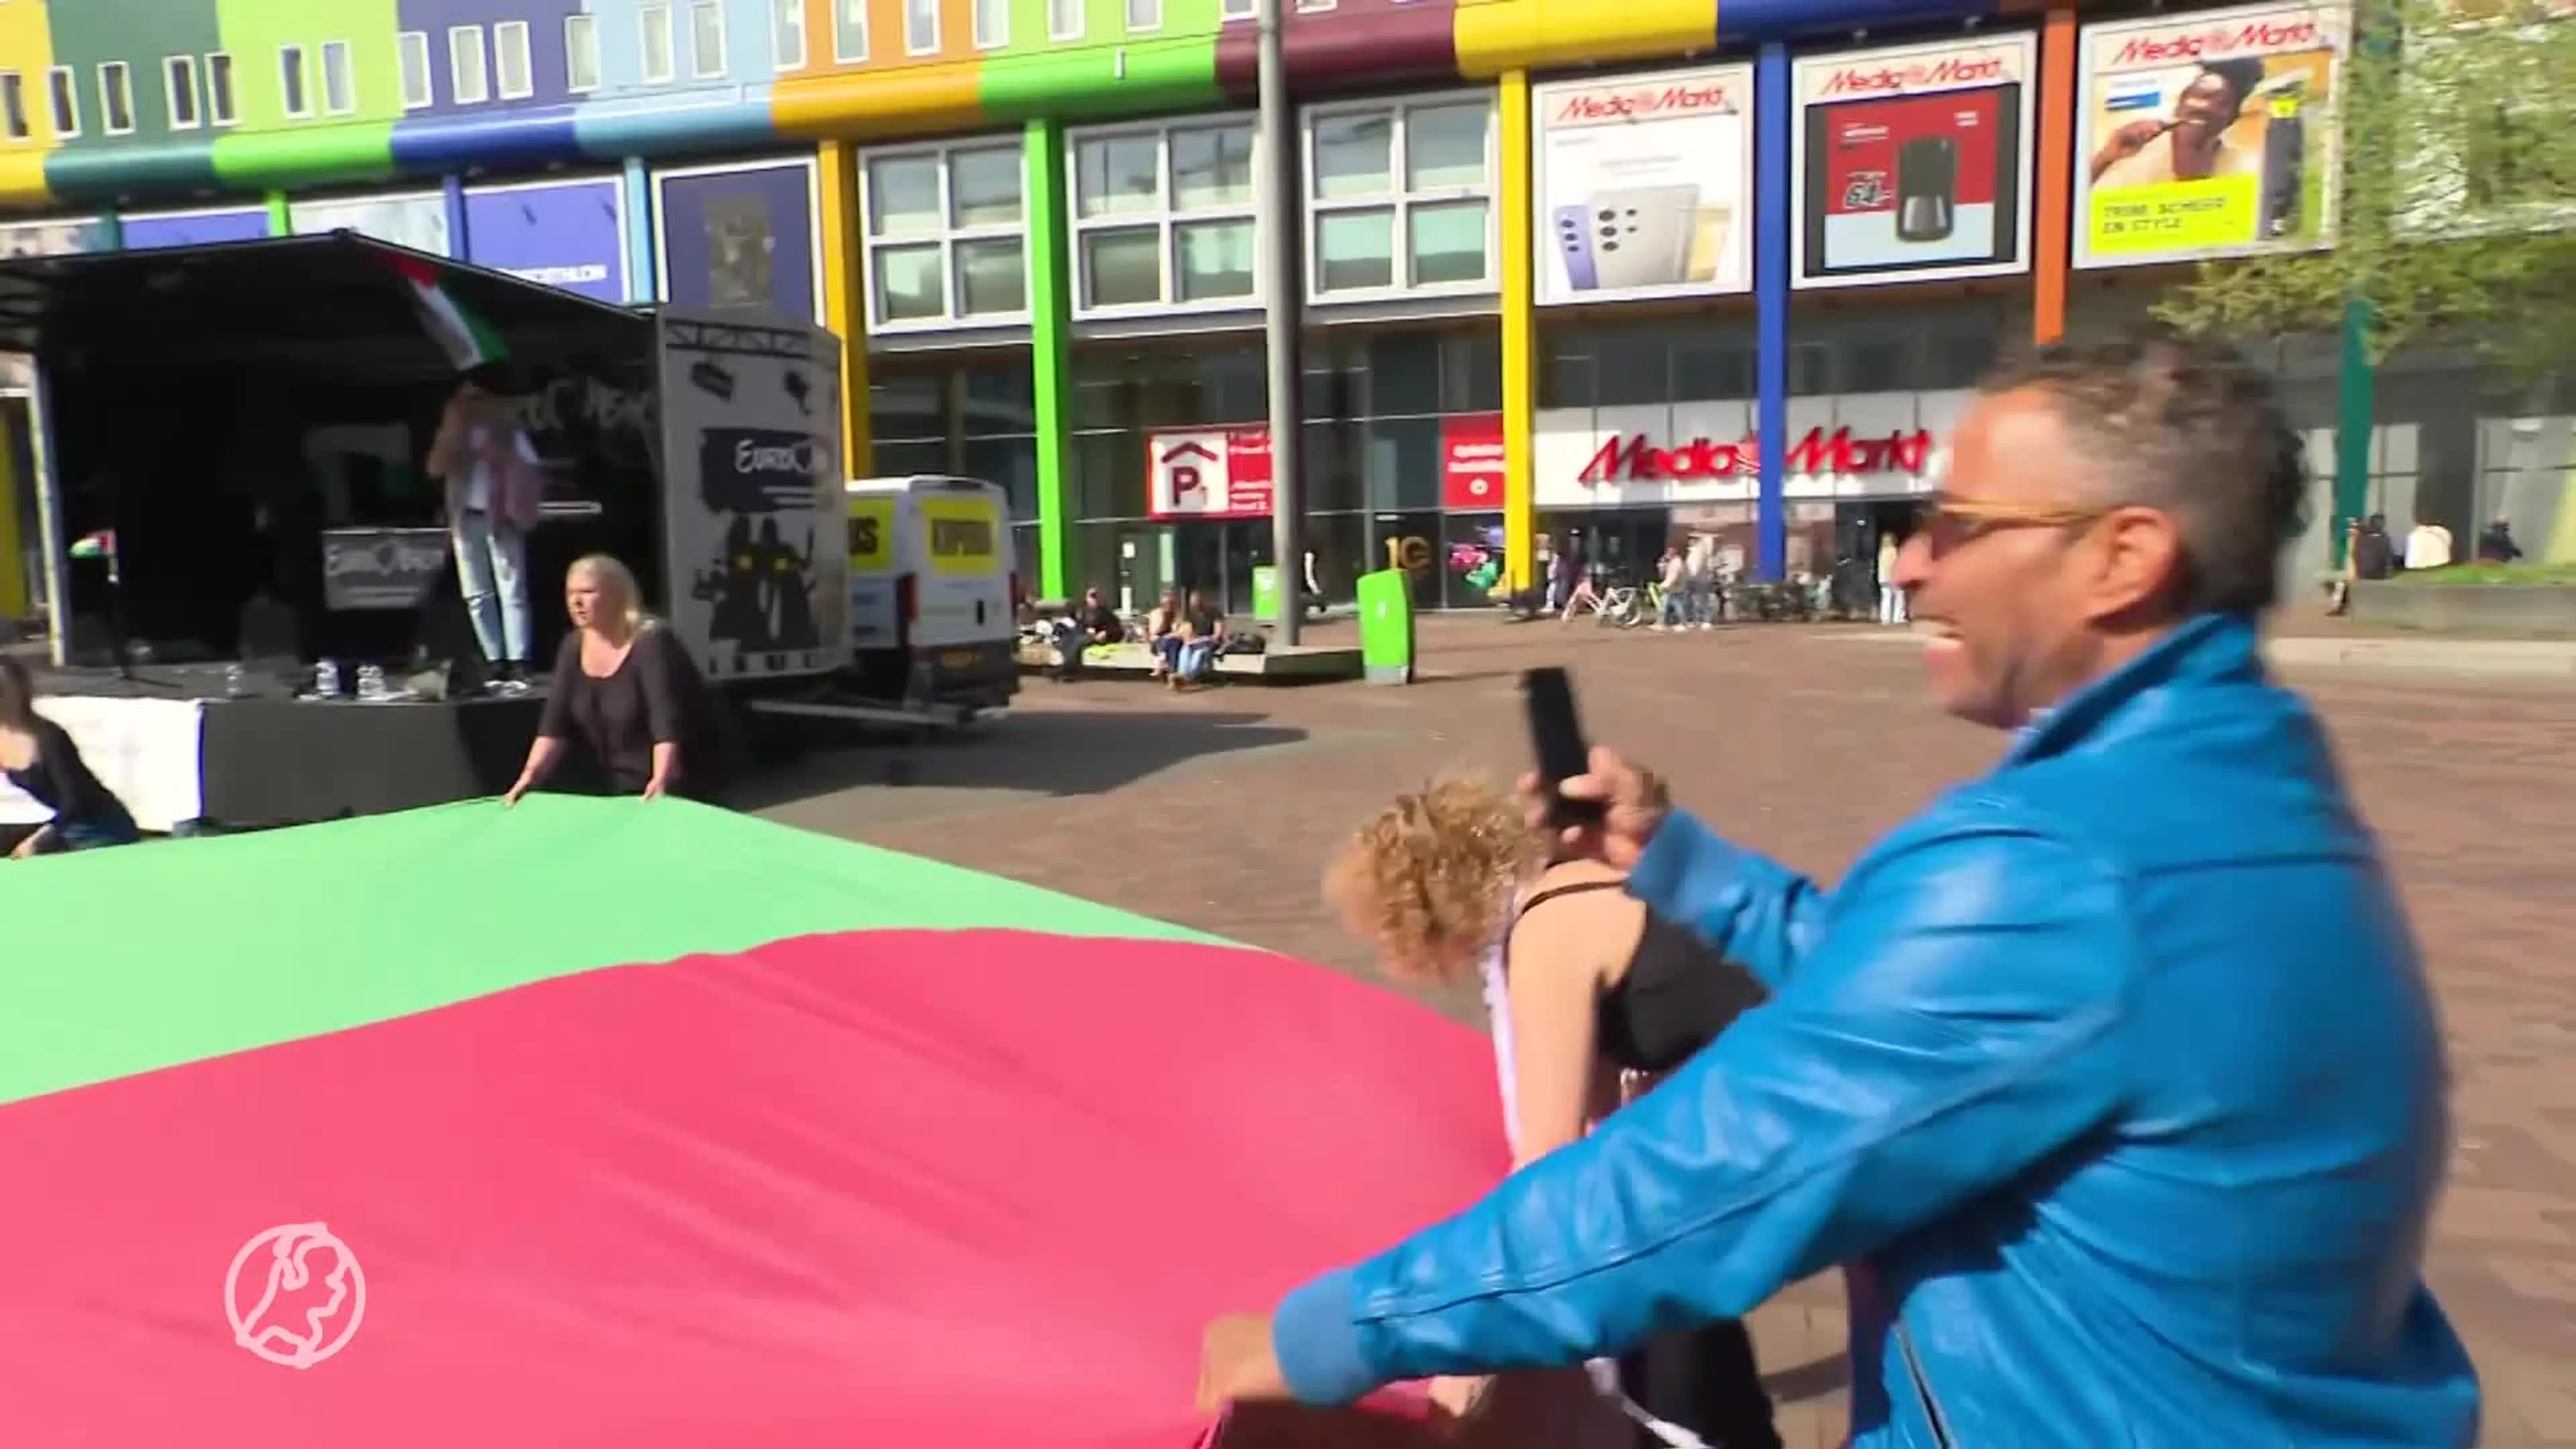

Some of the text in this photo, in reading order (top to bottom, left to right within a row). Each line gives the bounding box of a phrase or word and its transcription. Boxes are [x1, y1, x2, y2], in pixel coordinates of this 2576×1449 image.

[2112, 35, 2202, 65] Media
[1818, 67, 1903, 95] Media
[1557, 95, 1635, 121] Media
[1578, 425, 1932, 483] Media Markt
